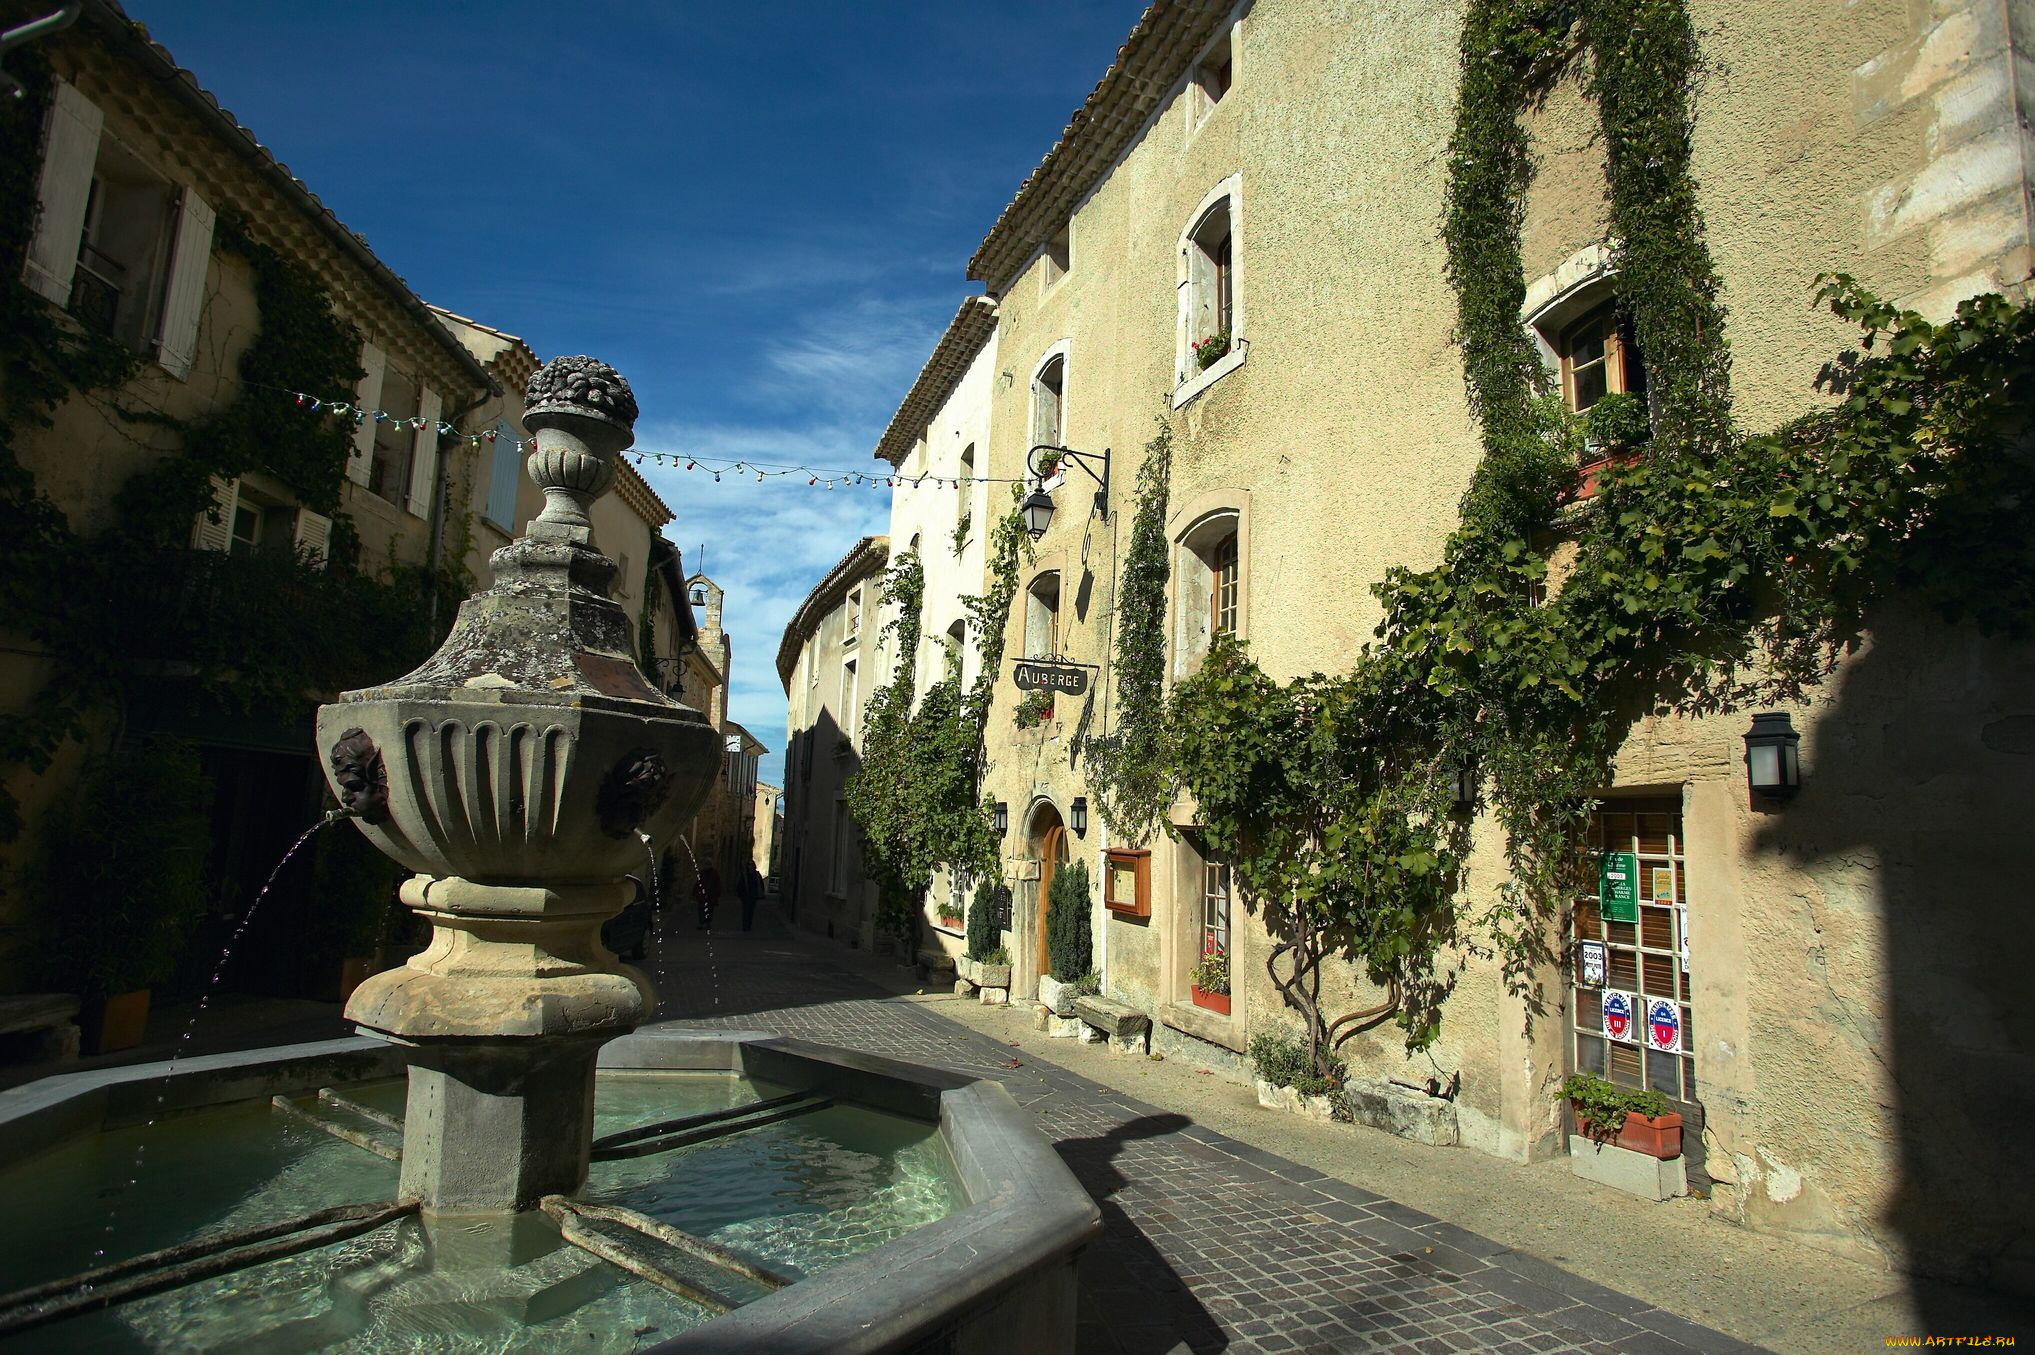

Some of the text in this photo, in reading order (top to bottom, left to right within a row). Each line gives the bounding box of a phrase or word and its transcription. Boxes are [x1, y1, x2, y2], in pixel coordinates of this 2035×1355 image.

[1018, 666, 1080, 687] AUBERGE
[1584, 951, 1603, 961] 2003
[1604, 992, 1629, 1010] VAUCLUSE
[1650, 1001, 1677, 1020] VAUCLUSE
[1655, 1016, 1672, 1024] LICENCE
